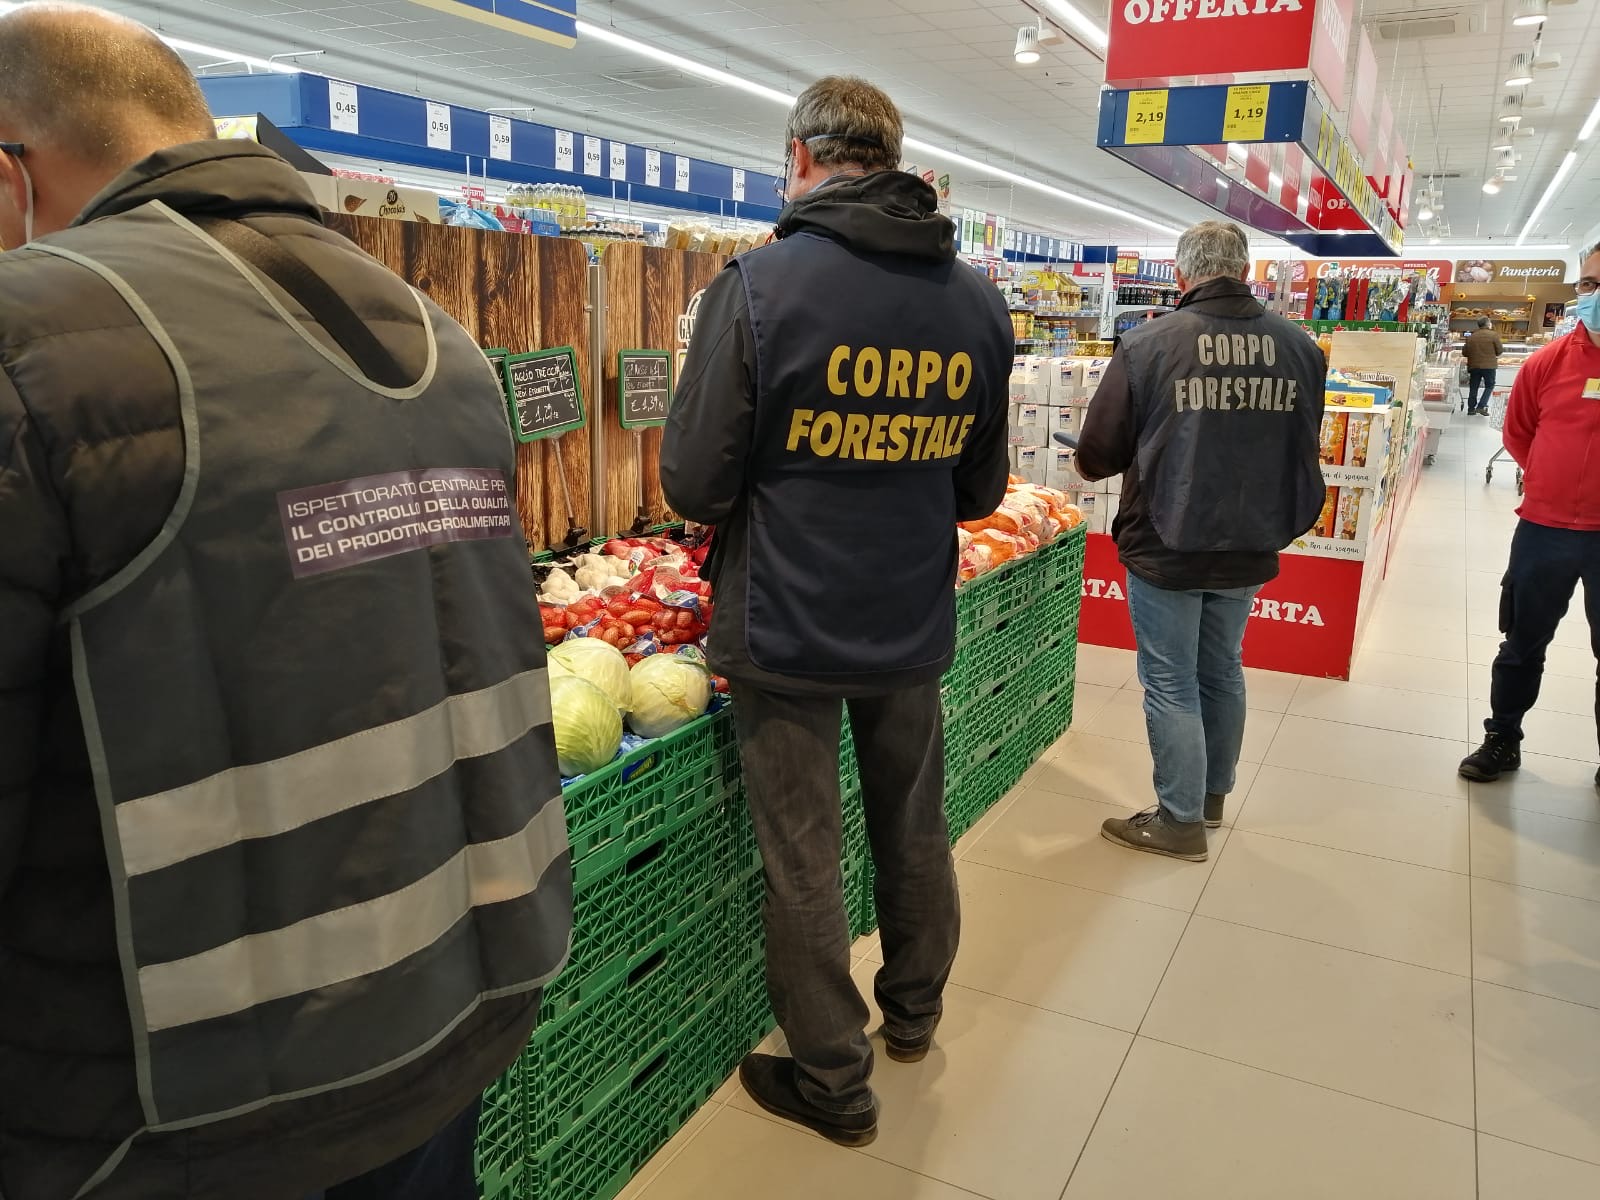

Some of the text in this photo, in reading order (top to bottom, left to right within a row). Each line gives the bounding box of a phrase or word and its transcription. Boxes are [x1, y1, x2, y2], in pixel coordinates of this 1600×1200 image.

[336, 101, 357, 114] 0,45
[1233, 107, 1264, 121] 1,19
[1136, 111, 1164, 125] 2,19
[431, 120, 449, 132] 0,59
[494, 133, 510, 144] 0,59
[558, 146, 572, 156] 0,59
[1326, 198, 1354, 210] OF
[1499, 265, 1561, 277] Panetteria
[1197, 333, 1276, 367] CORPO
[827, 344, 973, 401] CORPO
[1174, 376, 1297, 413] FORESTALE
[785, 408, 976, 462] FORESTALE
[287, 482, 417, 519] ISPETTORATO
[419, 479, 490, 494] CENTRALE
[291, 495, 509, 541] IL CONTROLLO DELLA QUALITÀ
[297, 542, 333, 563] DEI
